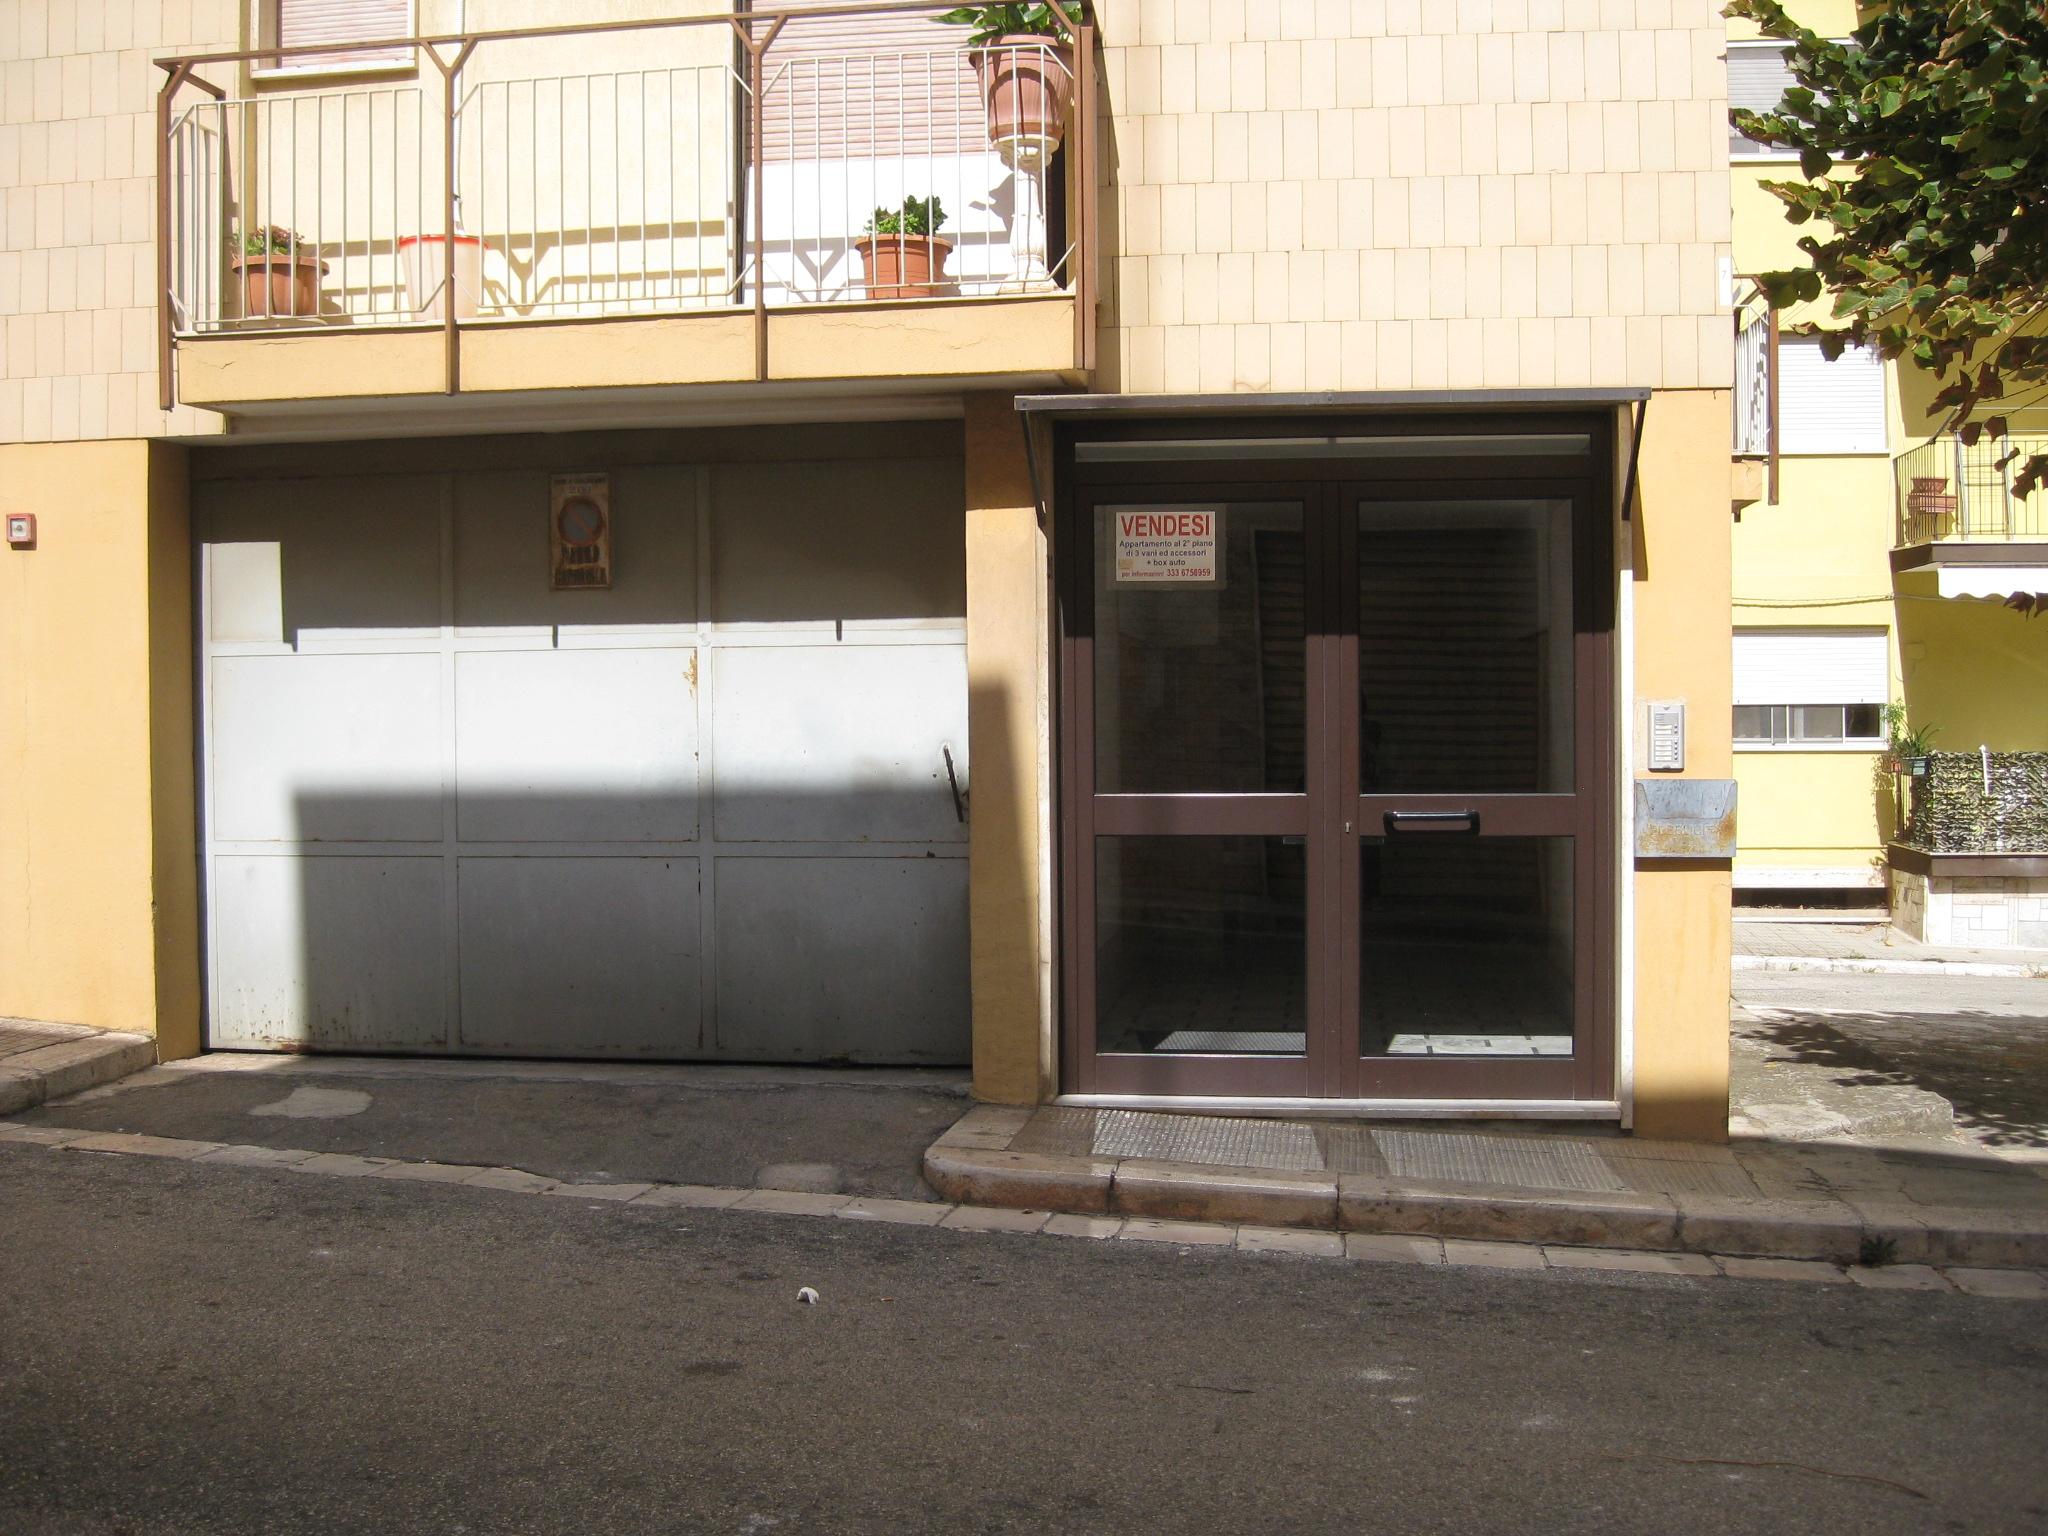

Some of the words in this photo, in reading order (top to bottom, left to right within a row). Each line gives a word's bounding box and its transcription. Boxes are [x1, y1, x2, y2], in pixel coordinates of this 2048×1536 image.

[1121, 514, 1210, 537] VENDESI
[1119, 540, 1172, 548] Appartamento
[1192, 540, 1213, 548] piano
[1166, 568, 1179, 577] 333
